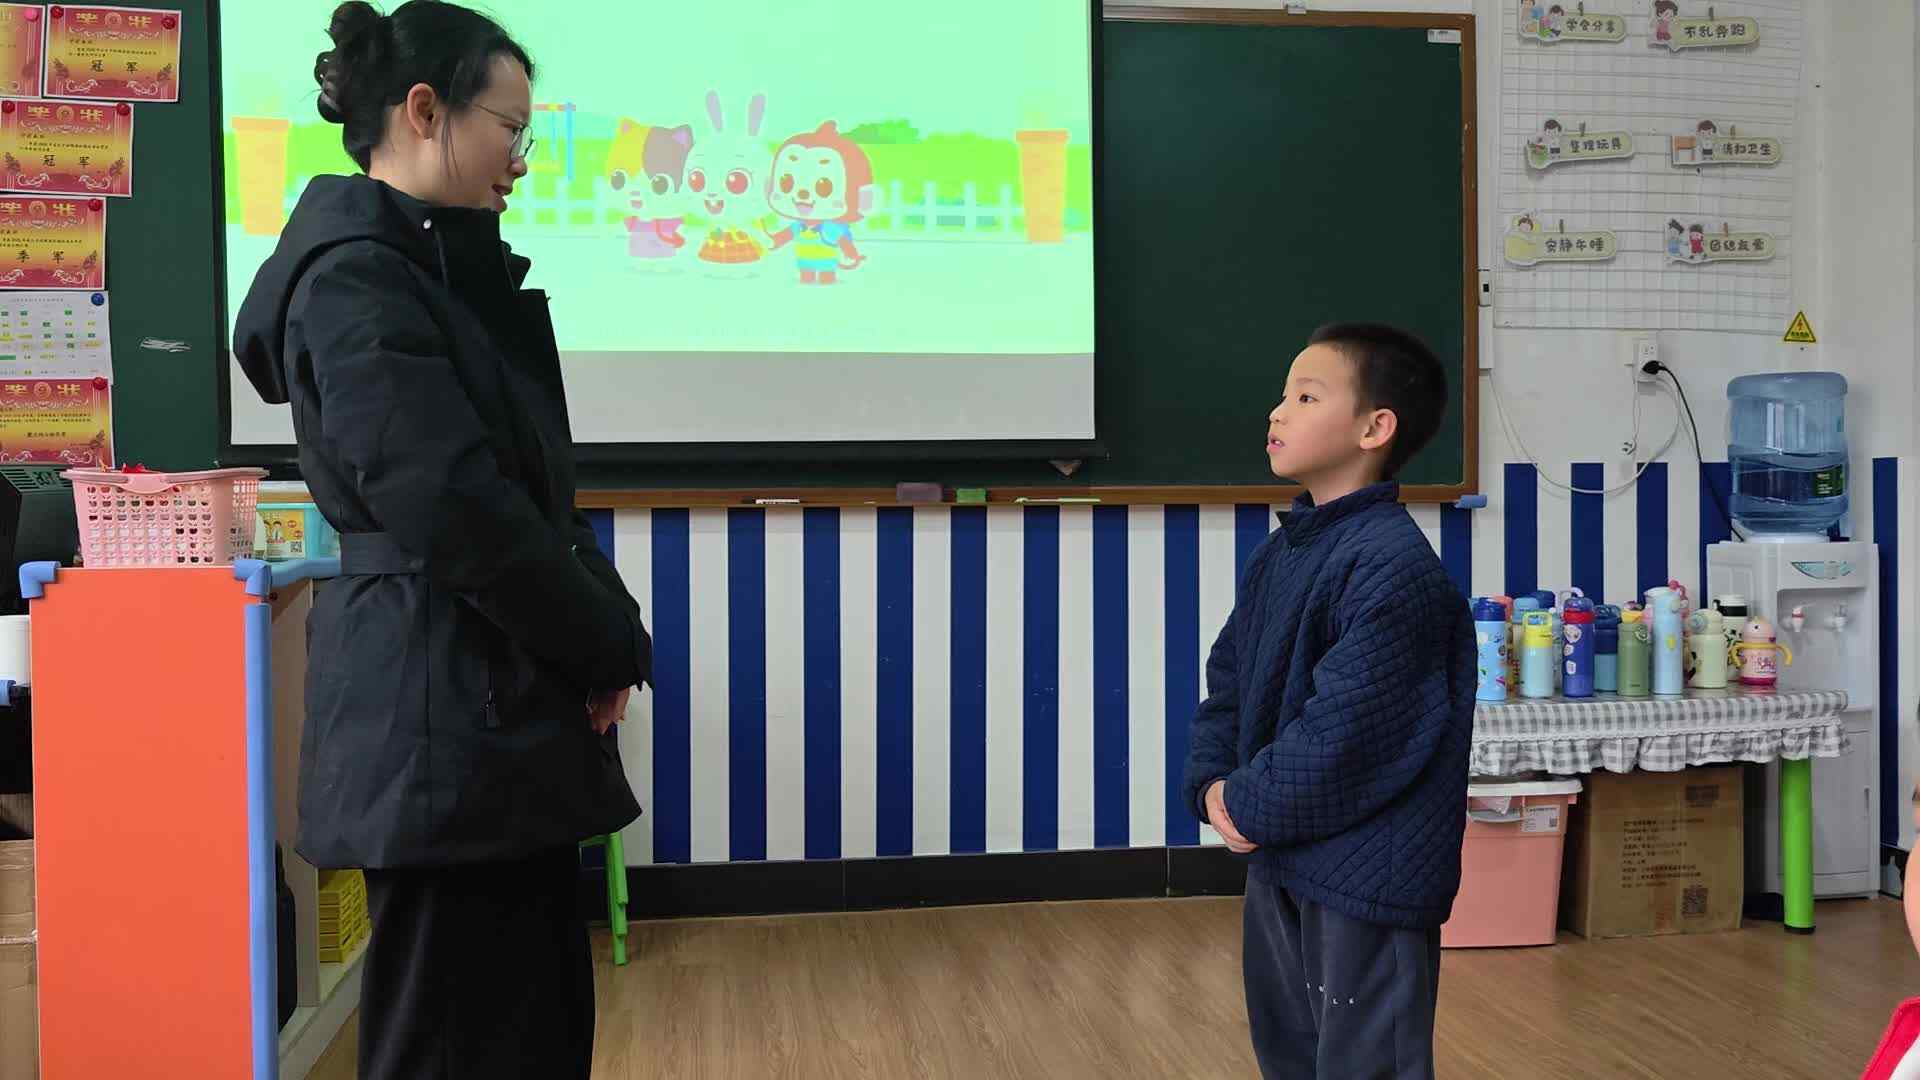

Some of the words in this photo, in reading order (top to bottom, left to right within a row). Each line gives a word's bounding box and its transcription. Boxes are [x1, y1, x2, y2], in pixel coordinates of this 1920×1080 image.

[1565, 17, 1616, 33] 学会分享
[1683, 23, 1746, 39] 不乱奔跑
[1569, 136, 1622, 154] 整理玩具
[1723, 141, 1772, 156] 清扫卫生
[1544, 236, 1605, 253] 安静午睡
[1709, 237, 1766, 253] 团结友爱
